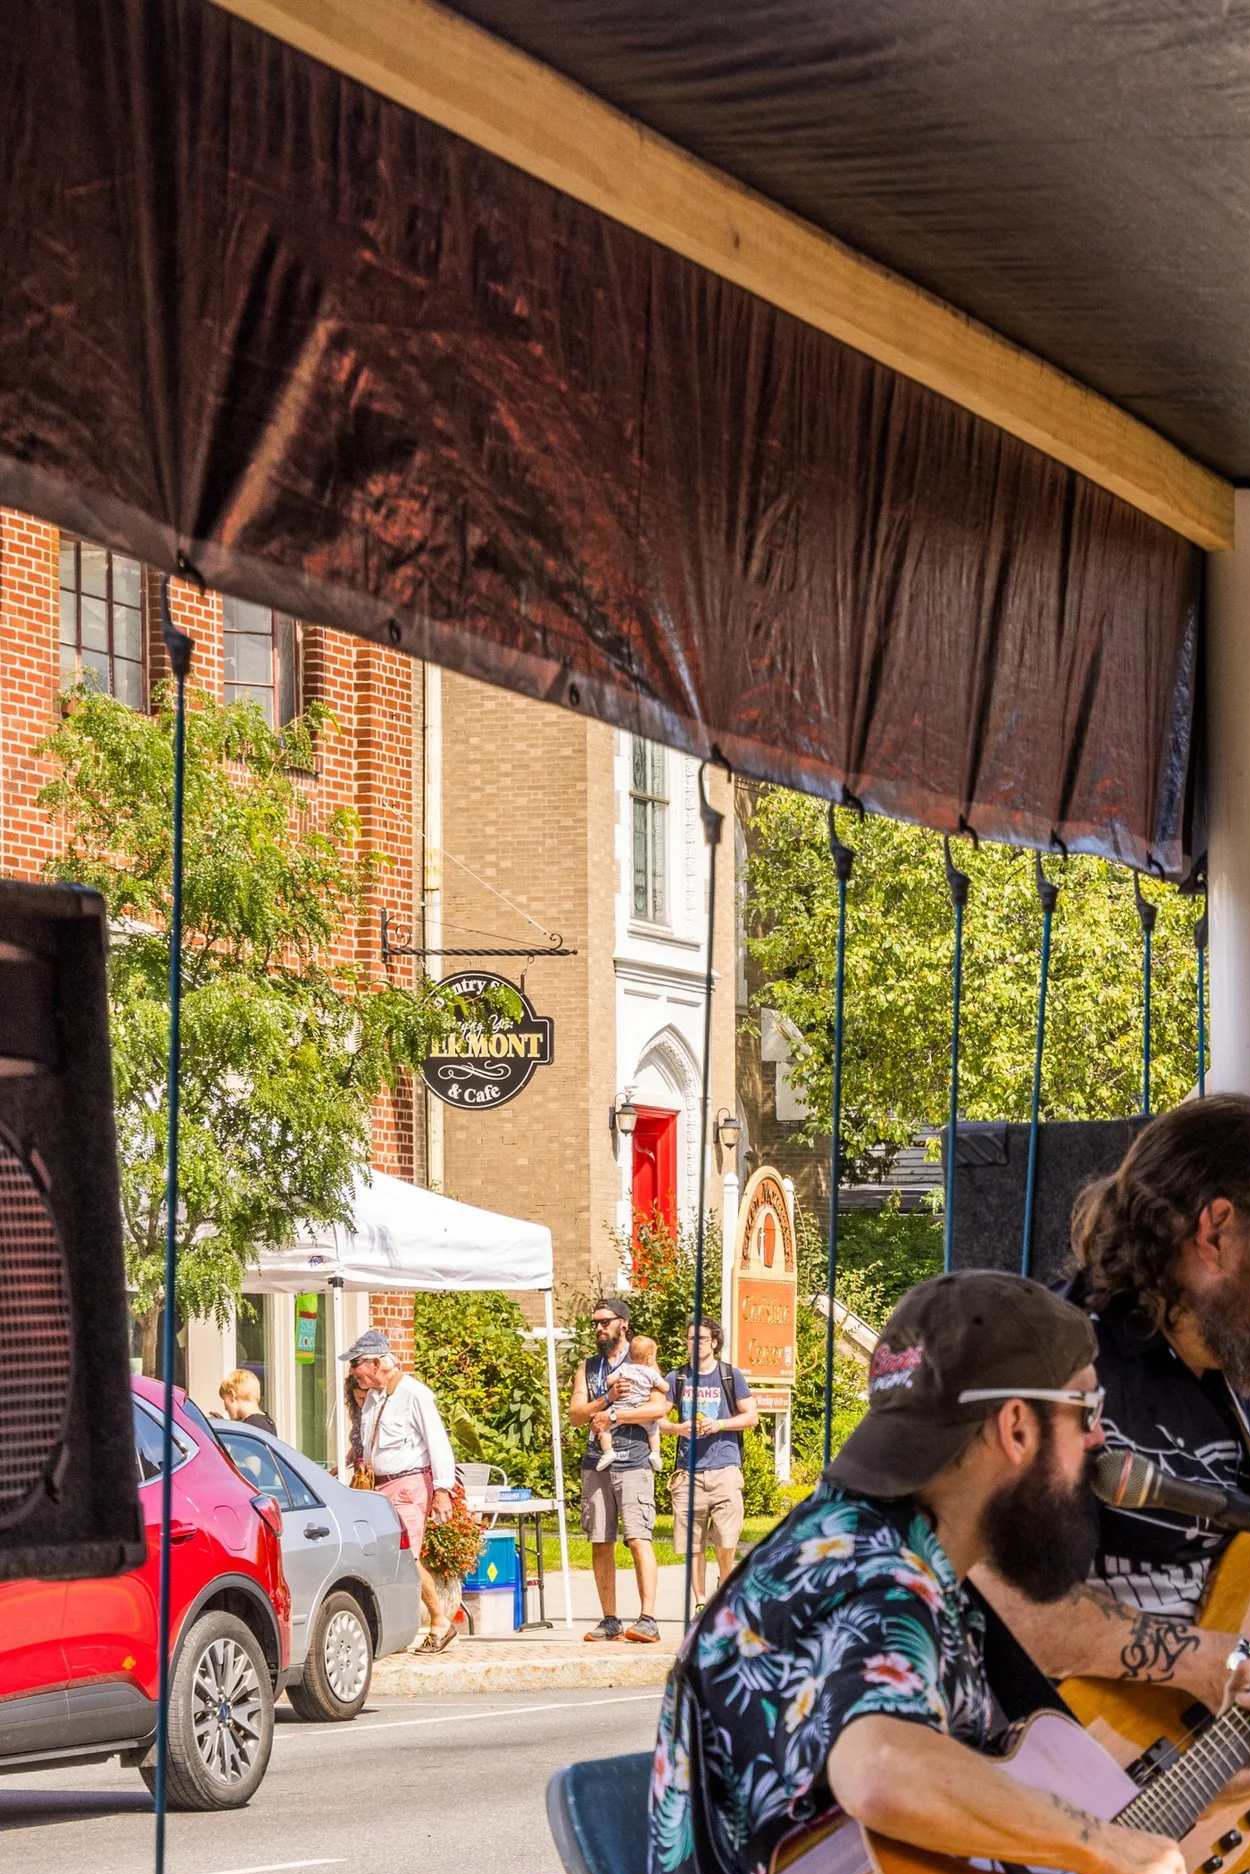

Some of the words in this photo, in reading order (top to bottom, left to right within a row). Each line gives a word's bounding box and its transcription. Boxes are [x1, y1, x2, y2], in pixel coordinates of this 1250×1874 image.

[429, 1033, 544, 1058] ERMONT
[447, 1082, 463, 1100] &
[463, 1083, 501, 1103] Cafe
[682, 1387, 720, 1399] MAHS
